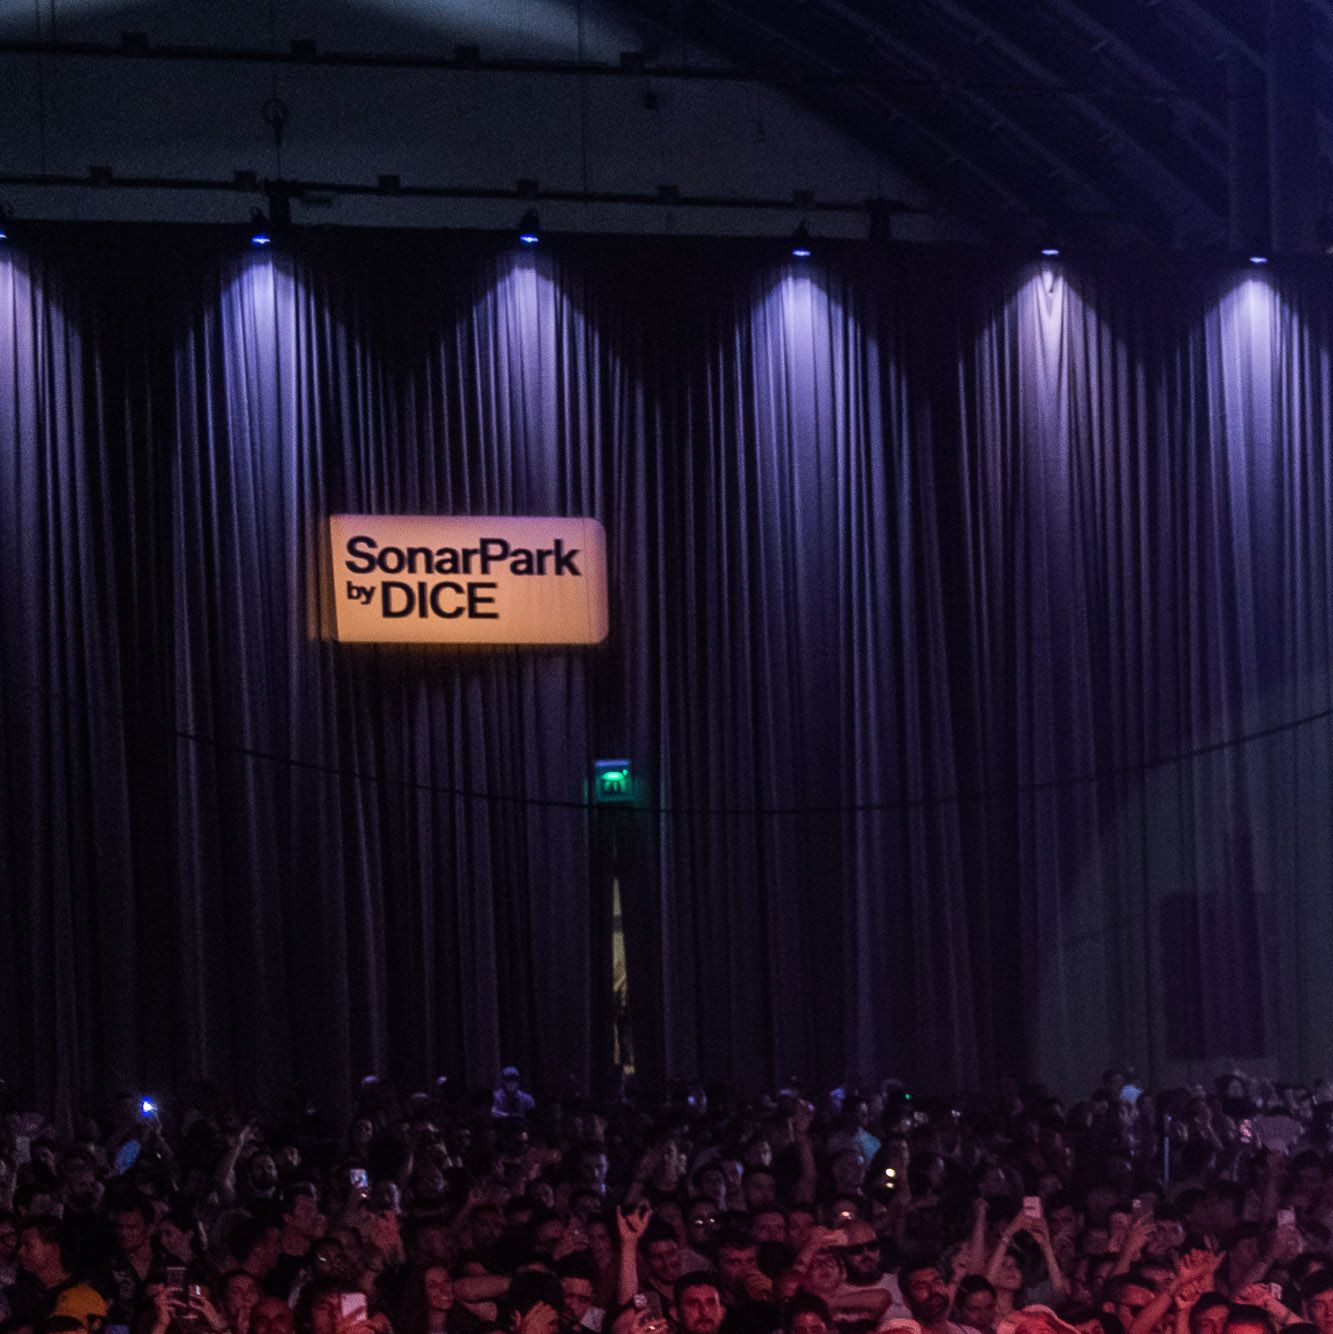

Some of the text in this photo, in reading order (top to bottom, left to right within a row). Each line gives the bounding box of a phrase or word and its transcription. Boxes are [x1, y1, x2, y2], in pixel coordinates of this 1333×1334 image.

[345, 535, 582, 577] SonarPark
[346, 580, 499, 619] by DICE
